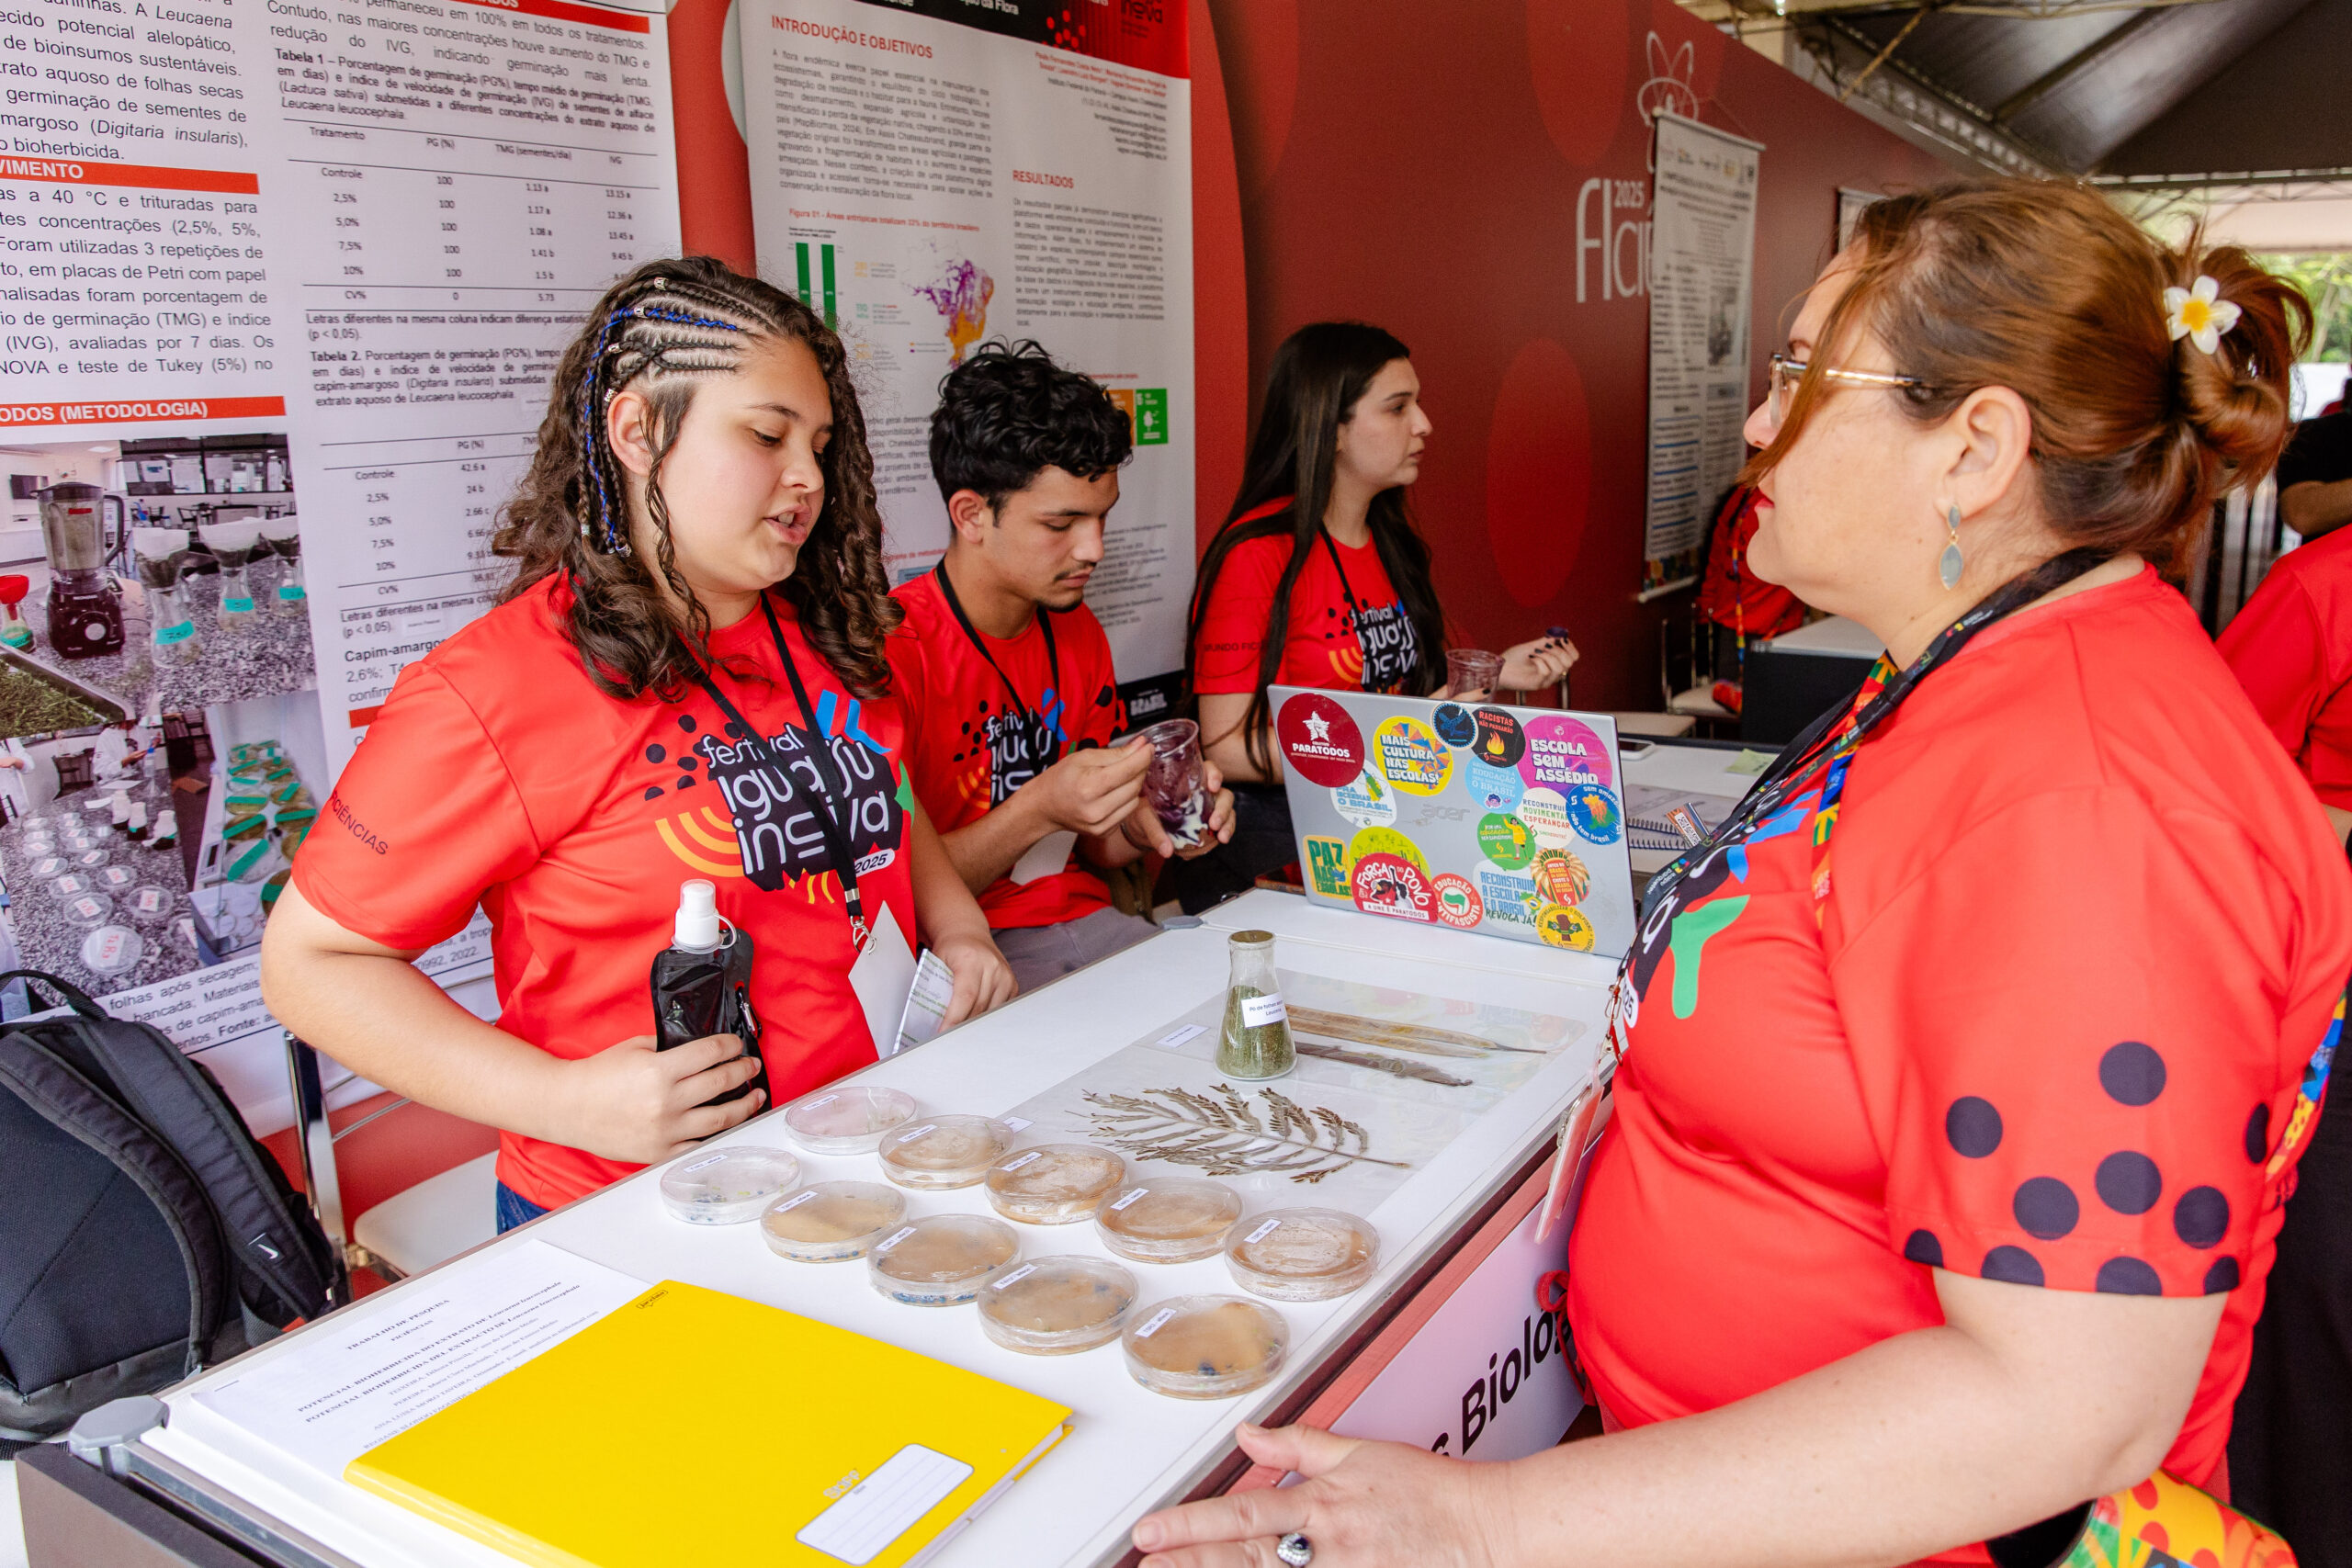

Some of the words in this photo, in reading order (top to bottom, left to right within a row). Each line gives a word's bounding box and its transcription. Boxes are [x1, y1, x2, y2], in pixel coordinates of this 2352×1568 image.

[135, 2, 148, 17] A
[156, 6, 232, 28] Leucaena
[58, 18, 135, 39] potencial
[147, 28, 236, 54] alelopático,
[267, 1, 331, 22] Contudo,
[338, 13, 361, 25] nas
[368, 17, 418, 34] maiores
[424, 26, 508, 48] concentrações
[512, 38, 545, 52] houve
[549, 46, 594, 61] aumento
[614, 53, 638, 67] TMG
[475, 12, 507, 27] 100%
[513, 21, 529, 30] em
[535, 22, 563, 37] todos
[586, 30, 648, 50] tratamentos.
[772, 15, 857, 44] INTRODUÇÃO
[861, 34, 866, 46] E
[869, 37, 933, 58] OBJETIVOS
[4, 35, 26, 51] de
[34, 38, 133, 64] bioinsumos
[140, 53, 241, 76] sustentáveis.
[270, 25, 327, 43] redução
[349, 35, 366, 47] do
[387, 39, 414, 56] IVG,
[434, 46, 490, 65] indicando
[507, 59, 569, 77] germinação
[584, 70, 607, 83] mais
[275, 49, 312, 62] Tabela
[318, 54, 323, 63] 1
[339, 56, 406, 75] Porcentagem
[46, 67, 109, 85] aquoso
[117, 73, 138, 88] de
[144, 74, 192, 95] folhas
[198, 85, 243, 100] secas
[6, 89, 110, 111] germinação
[118, 97, 138, 113] de
[145, 102, 221, 122] sementes
[228, 108, 246, 123] de
[90, 118, 164, 141] (Digitaria
[310, 127, 366, 140] Tratamento
[14, 137, 125, 160] bioherbicida.
[321, 168, 363, 180] Controle
[1013, 170, 1074, 188] RESULTADOS
[52, 189, 74, 204] 40
[119, 196, 130, 207] e
[141, 194, 214, 212] trituradas
[224, 201, 257, 216] para
[39, 216, 161, 234] concentrações
[232, 222, 260, 237] 5%,
[60, 240, 138, 255] utilizadas
[144, 243, 154, 255] 3
[161, 244, 239, 260] repetições
[244, 245, 263, 259] de
[29, 265, 55, 276] em
[62, 263, 117, 280] placas
[122, 265, 142, 278] de
[148, 265, 184, 279] Petri
[188, 269, 220, 280] com
[226, 268, 266, 285] papel
[87, 288, 135, 302] foram
[143, 290, 243, 305] porcentagem
[249, 290, 267, 304] de
[24, 311, 45, 325] de
[52, 312, 151, 329] germinação
[156, 311, 207, 328] (TMG)
[212, 315, 222, 326] e
[6, 335, 59, 353] (IVG),
[69, 336, 147, 350] avaliadas
[157, 338, 183, 353] por
[190, 336, 199, 348] 7
[209, 335, 244, 349] dias.
[253, 336, 275, 348] Os
[311, 351, 346, 362] Tabela
[366, 350, 430, 364] Porcentagem
[58, 363, 69, 374] e
[78, 360, 119, 373] teste
[128, 359, 148, 373] de
[156, 359, 203, 375] Tukey
[211, 358, 247, 374] (5%)
[254, 360, 273, 371] no
[60, 402, 208, 423] (METODOLOGIA)
[355, 469, 395, 480] Controle
[1479, 711, 1514, 727] RACISTAS
[1292, 742, 1351, 758] PARATODOS
[1381, 735, 1410, 747] MAIS
[1530, 739, 1588, 756] ESCOLA
[1383, 746, 1434, 761] CULTURA
[1385, 757, 1409, 769] NAS
[1386, 769, 1440, 784] ESCOLAS!
[1535, 766, 1599, 784] ASSÉDIO
[1420, 804, 1470, 821] acer
[1523, 815, 1570, 829] ESPERANÇAR
[1307, 840, 1343, 866] PAZ
[854, 852, 888, 874] 2025
[1402, 867, 1431, 906] POVO
[1434, 876, 1472, 894] EDUCAÇÃO
[1490, 886, 1520, 902] ESCOLA
[1498, 901, 1525, 915] BRASIL
[110, 993, 153, 1010] folhas
[160, 981, 192, 997] após
[219, 1019, 260, 1036] Fonte:
